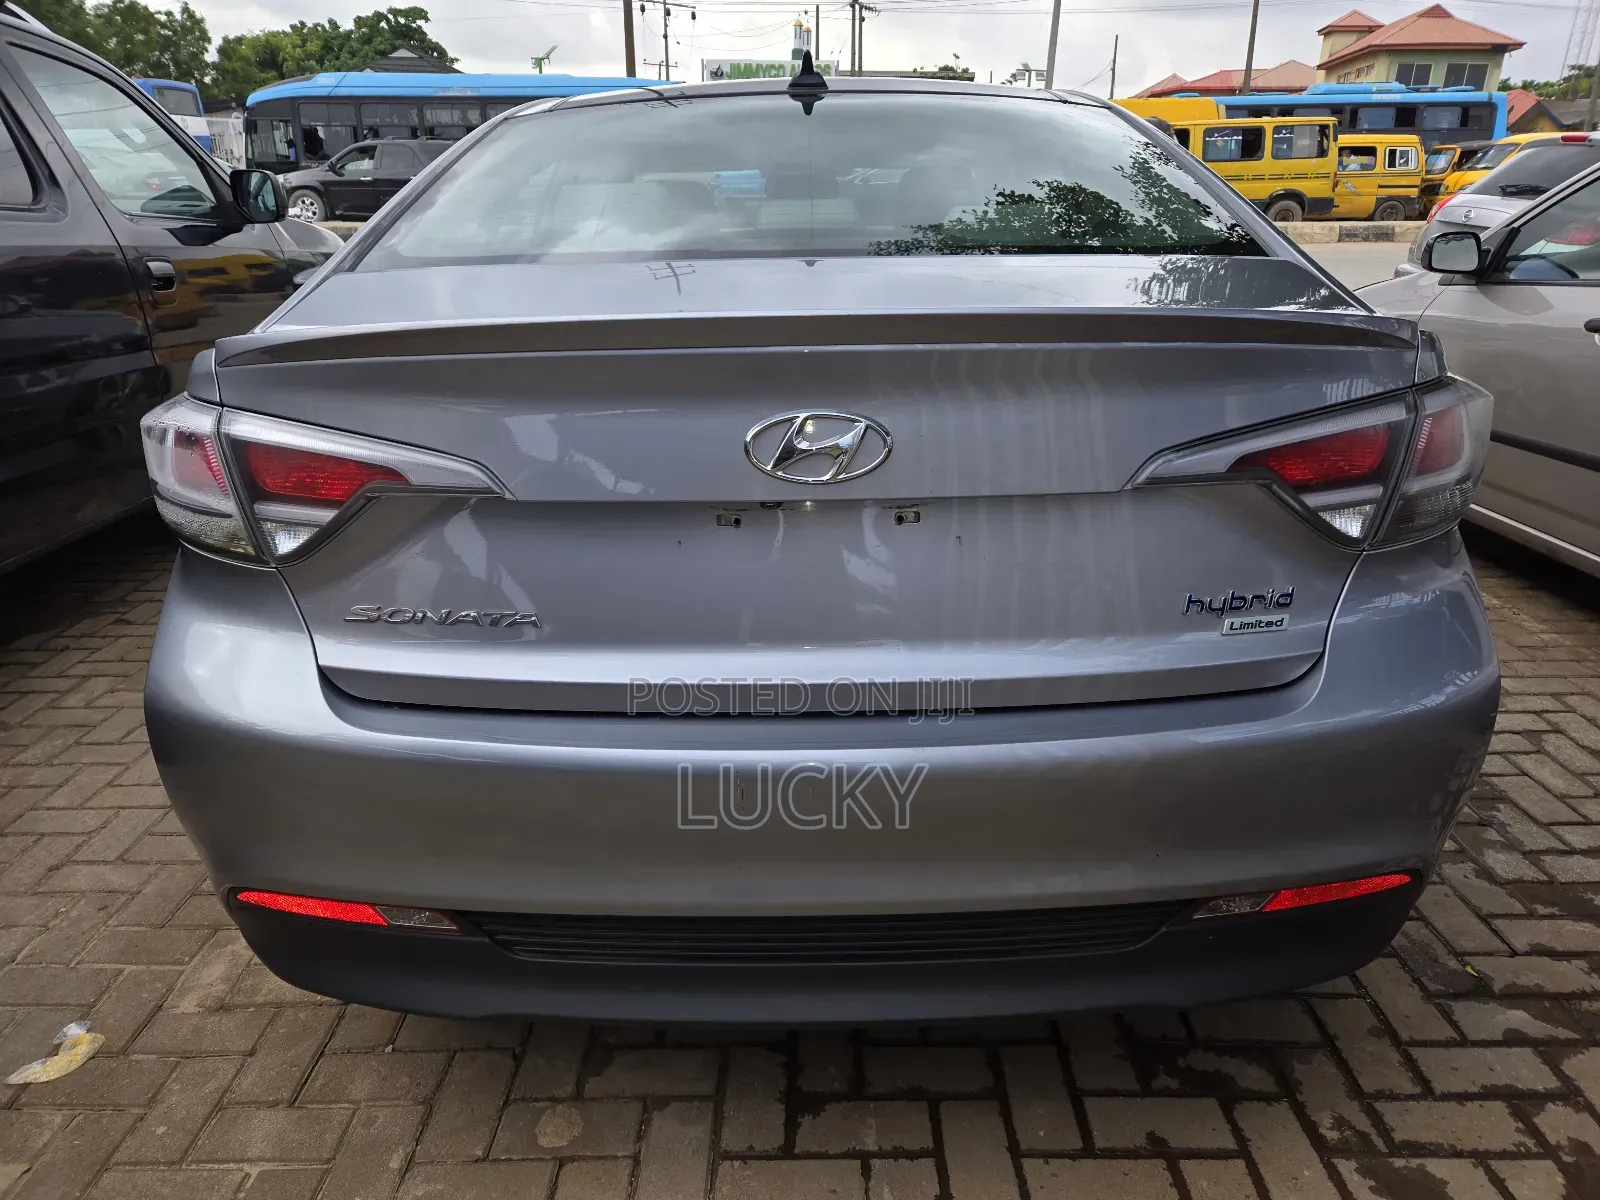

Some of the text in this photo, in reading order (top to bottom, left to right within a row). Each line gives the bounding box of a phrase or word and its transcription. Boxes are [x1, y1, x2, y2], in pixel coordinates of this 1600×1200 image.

[726, 62, 786, 79] JIMMYCO
[1183, 586, 1296, 617] hybrid
[343, 604, 541, 628] SONATA
[1229, 617, 1285, 631] Limited
